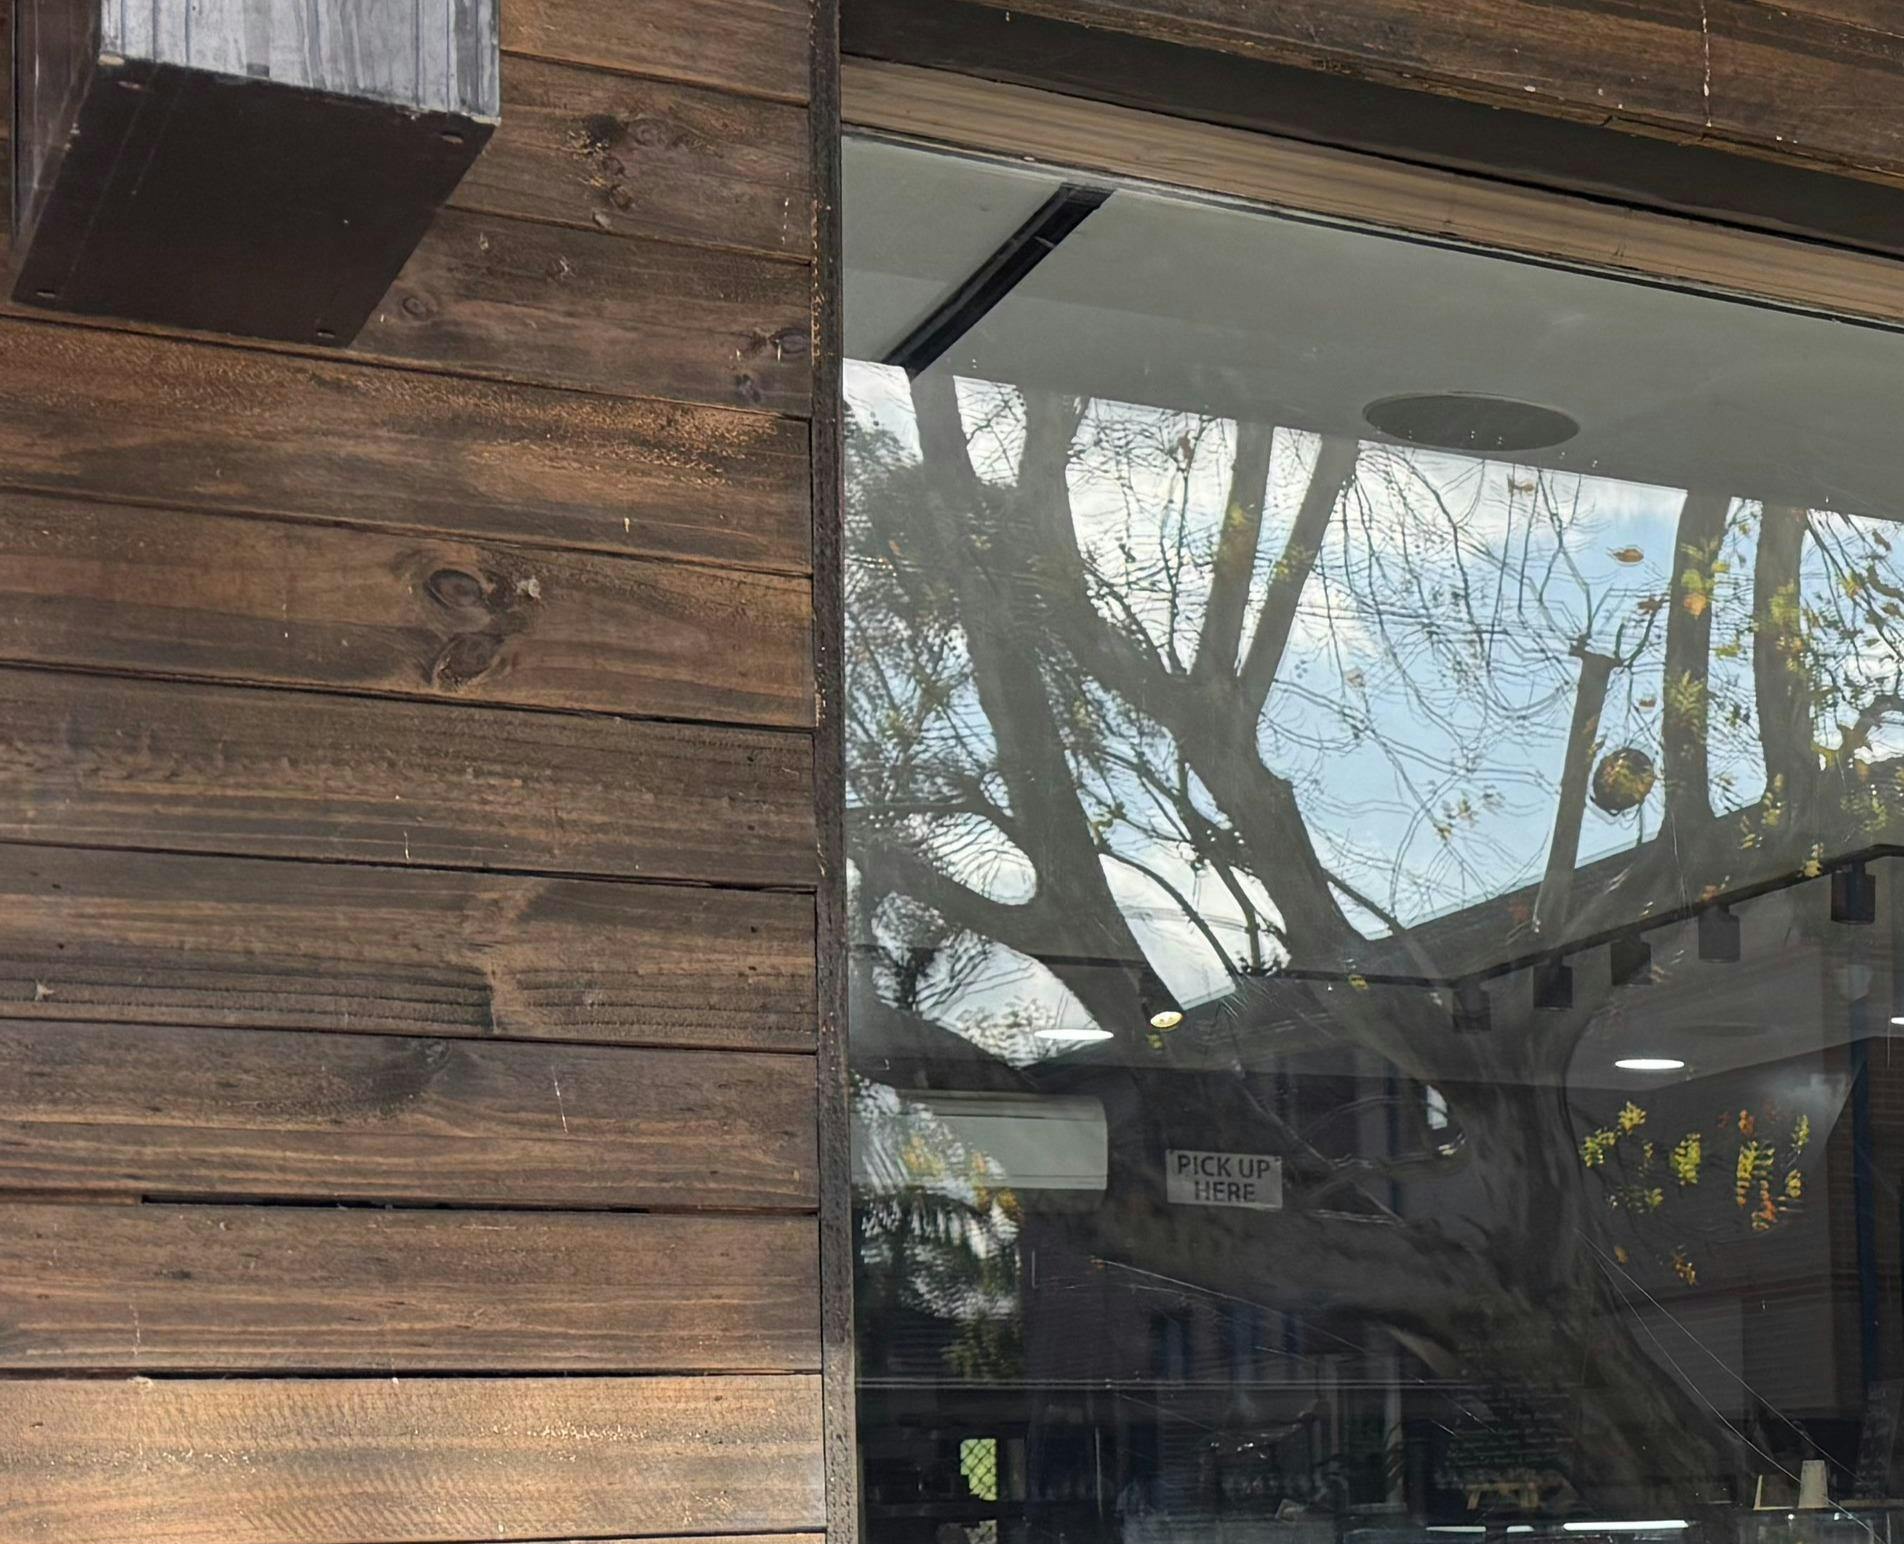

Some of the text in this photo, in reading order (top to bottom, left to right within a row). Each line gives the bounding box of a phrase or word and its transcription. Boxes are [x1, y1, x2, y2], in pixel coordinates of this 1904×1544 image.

[1177, 1154, 1271, 1179] PICK UP
[1195, 1181, 1257, 1202] HERE
